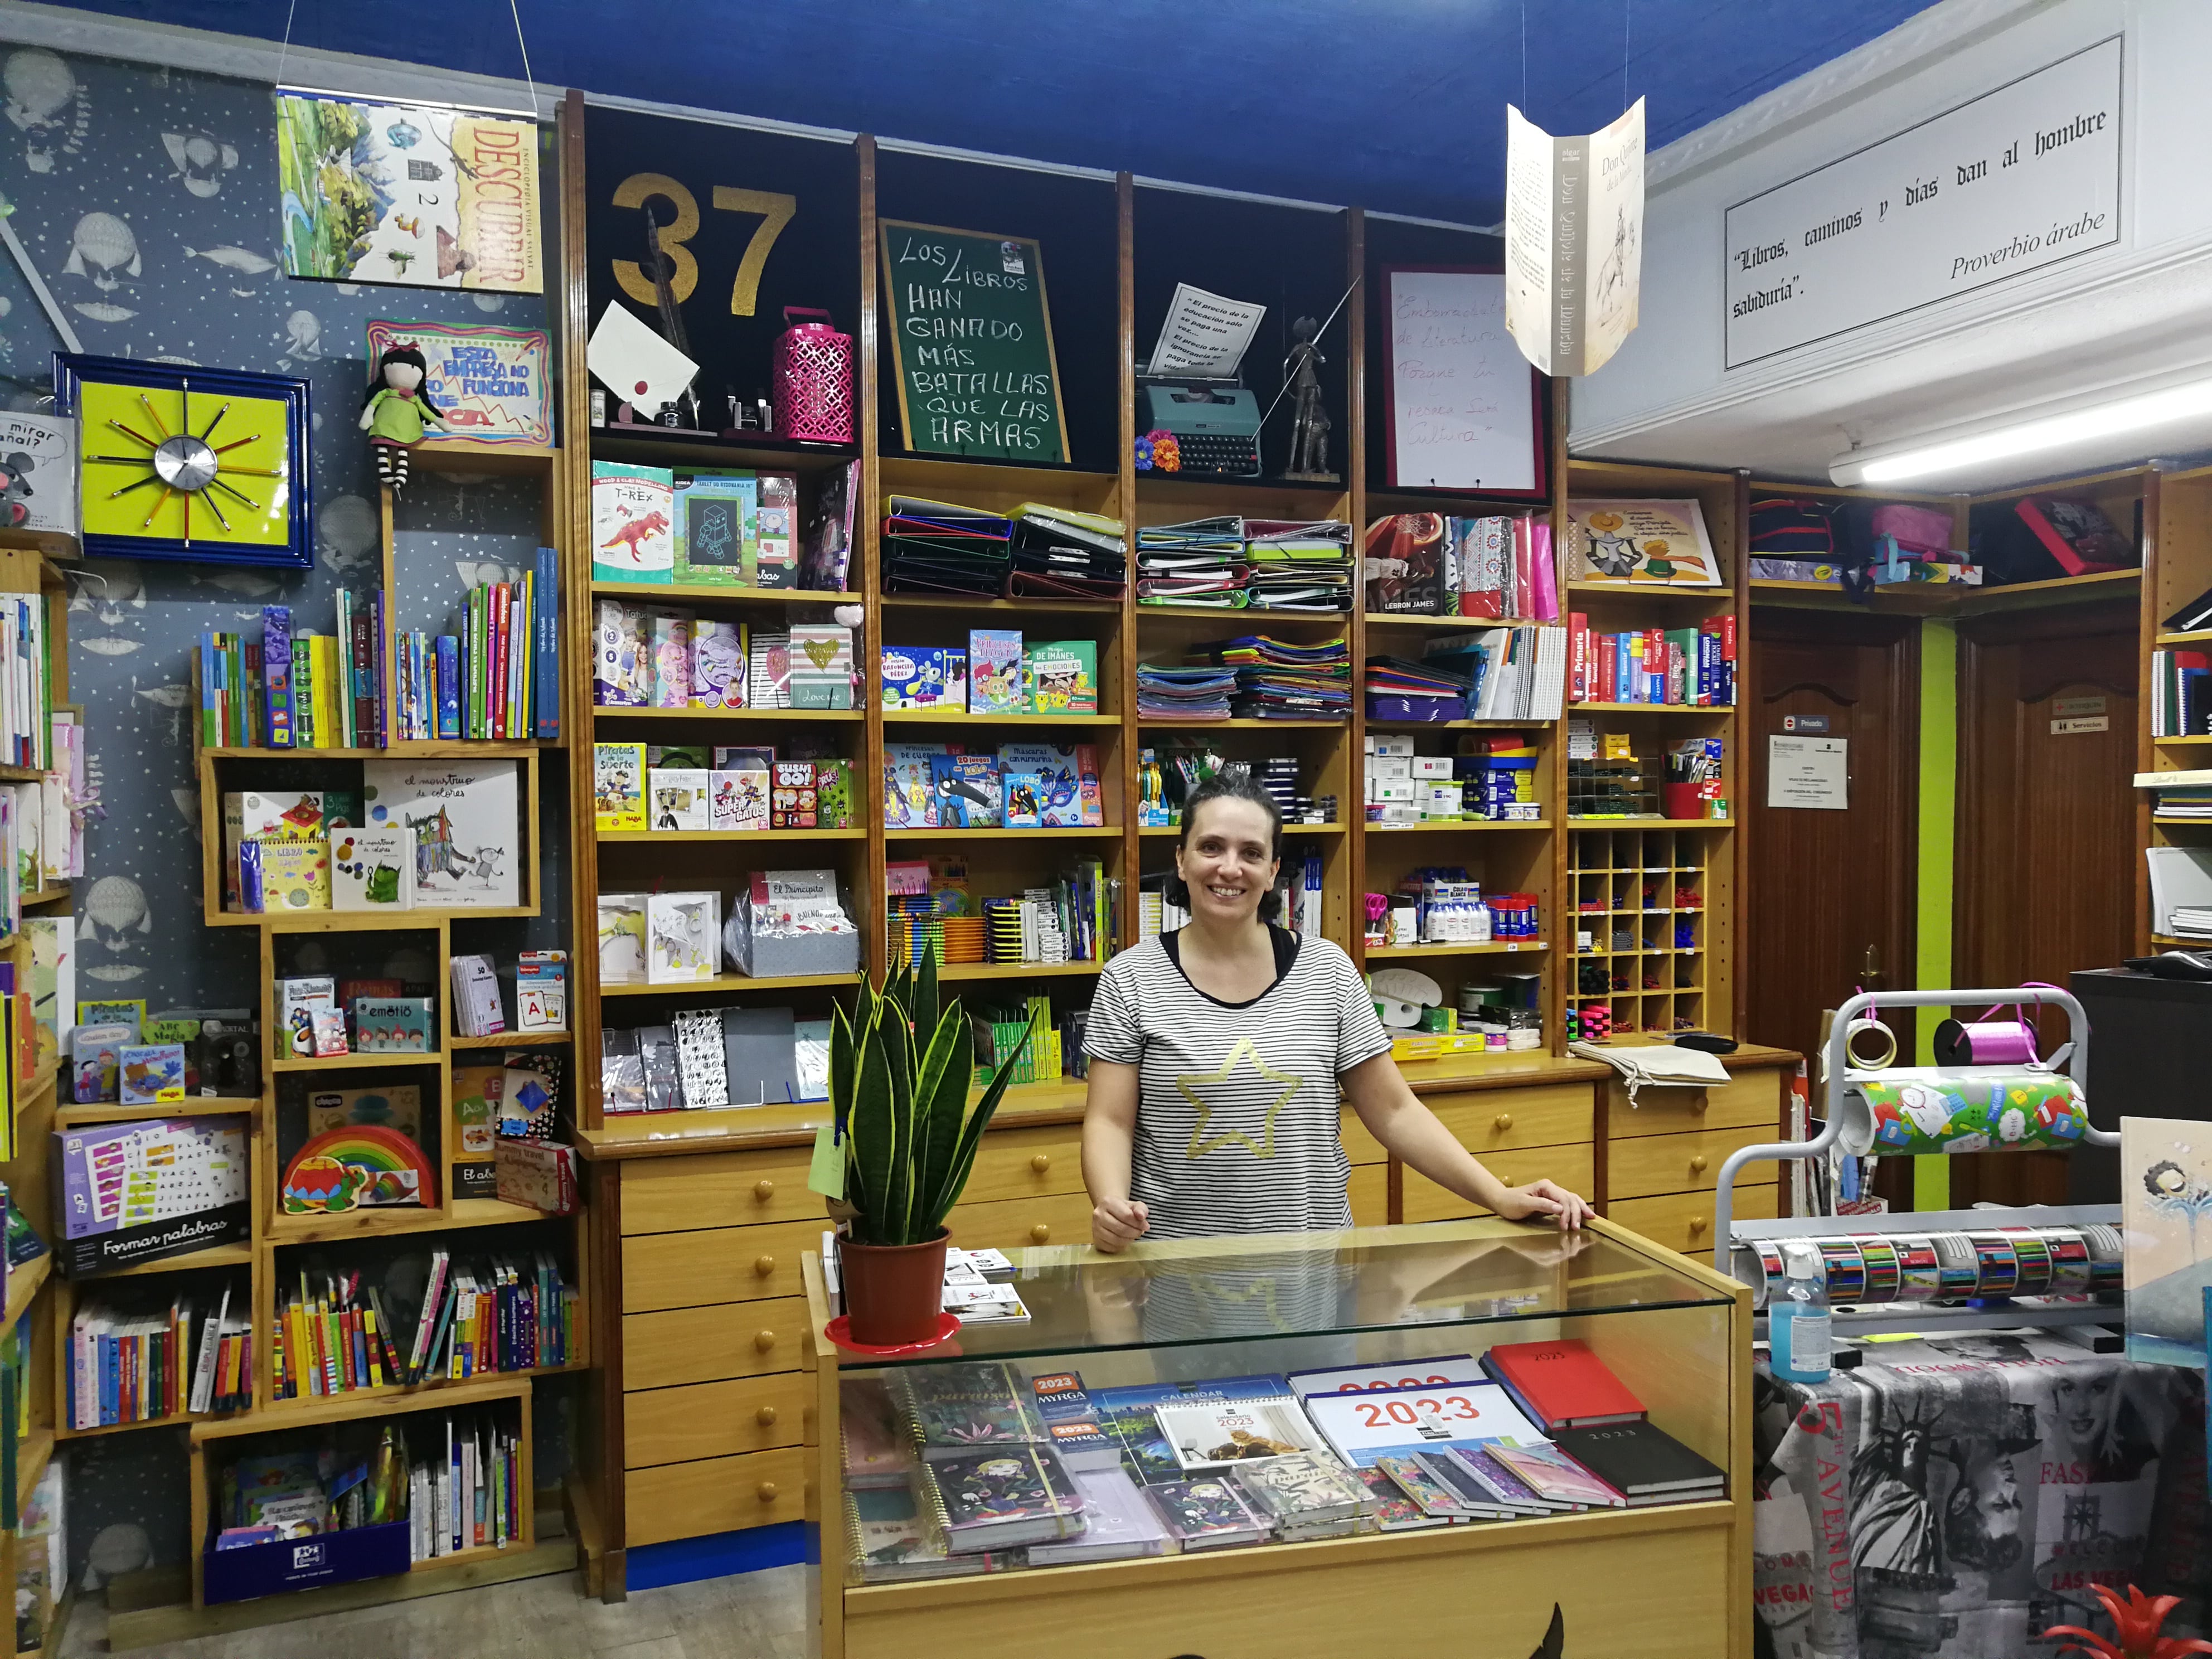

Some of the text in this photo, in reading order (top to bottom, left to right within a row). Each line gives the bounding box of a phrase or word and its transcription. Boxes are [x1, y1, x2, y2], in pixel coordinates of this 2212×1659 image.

[1602, 156, 1618, 176] Don
[522, 147, 532, 210] ENCICLOPEDIA
[1804, 207, 1862, 248] caminos
[1879, 200, 1889, 223] y
[1905, 177, 1938, 207] días
[1956, 158, 1988, 187] dan
[2002, 142, 2019, 169] al
[2034, 110, 2107, 159] hombre
[418, 192, 439, 205] 2
[473, 127, 525, 283] DESCUBRIR
[612, 172, 796, 316] 37
[900, 236, 946, 266] LOS
[1951, 211, 2106, 280] Proverbio árabe
[908, 283, 962, 313] HAN
[1183, 307, 1225, 323] educación
[1201, 302, 1228, 315] precio
[906, 318, 1022, 341] GANADO
[1190, 319, 1211, 330] paga
[1212, 326, 1228, 334] una
[1184, 337, 1208, 351] precio
[1396, 328, 1412, 346] de
[451, 346, 498, 360] ESTA
[918, 343, 974, 367] MÁS
[1170, 342, 1211, 359] ignorancia
[1166, 352, 1187, 366] paga
[443, 360, 530, 379] EMPRESA NO
[463, 379, 530, 397] FUNCIONA
[912, 371, 1050, 395] BATALLAS
[926, 397, 1050, 422] QUE LAS
[11, 423, 56, 441] mirar
[930, 417, 1041, 449] ARMAS
[1036, 652, 1046, 660] DE
[1575, 632, 1584, 672] Primaria
[1043, 662, 1080, 671] EMOCIONES
[801, 690, 826, 702] Love
[598, 744, 635, 756] Piratas
[968, 756, 991, 765] juegos
[405, 775, 476, 787] el monstruo
[668, 775, 679, 784] Harry
[779, 773, 810, 786] GO!
[416, 789, 465, 798] de colores
[714, 803, 746, 817] SUPER
[735, 806, 765, 822] GATOS
[365, 838, 397, 847] monstruo
[774, 884, 823, 895] El Principito
[528, 1002, 540, 1015] A
[523, 1147, 545, 1161] travel
[463, 1168, 474, 1180] El
[104, 1221, 228, 1255] Formar palabras
[1895, 1354, 2067, 1375] HOLLYWOOD
[1037, 1377, 1073, 1390] 2023
[1038, 1391, 1087, 1404] MYRGA
[1161, 1390, 1223, 1401] CALENDAR
[1355, 1396, 1481, 1428] 2023
[1056, 1424, 1092, 1435] 2023
[1217, 1418, 1254, 1427] 2023
[1057, 1433, 1107, 1444] MYRGA
[1589, 1429, 1636, 1440] 2023
[1816, 1458, 1854, 1611] AVENUE
[2051, 1571, 2085, 1590] LAS
